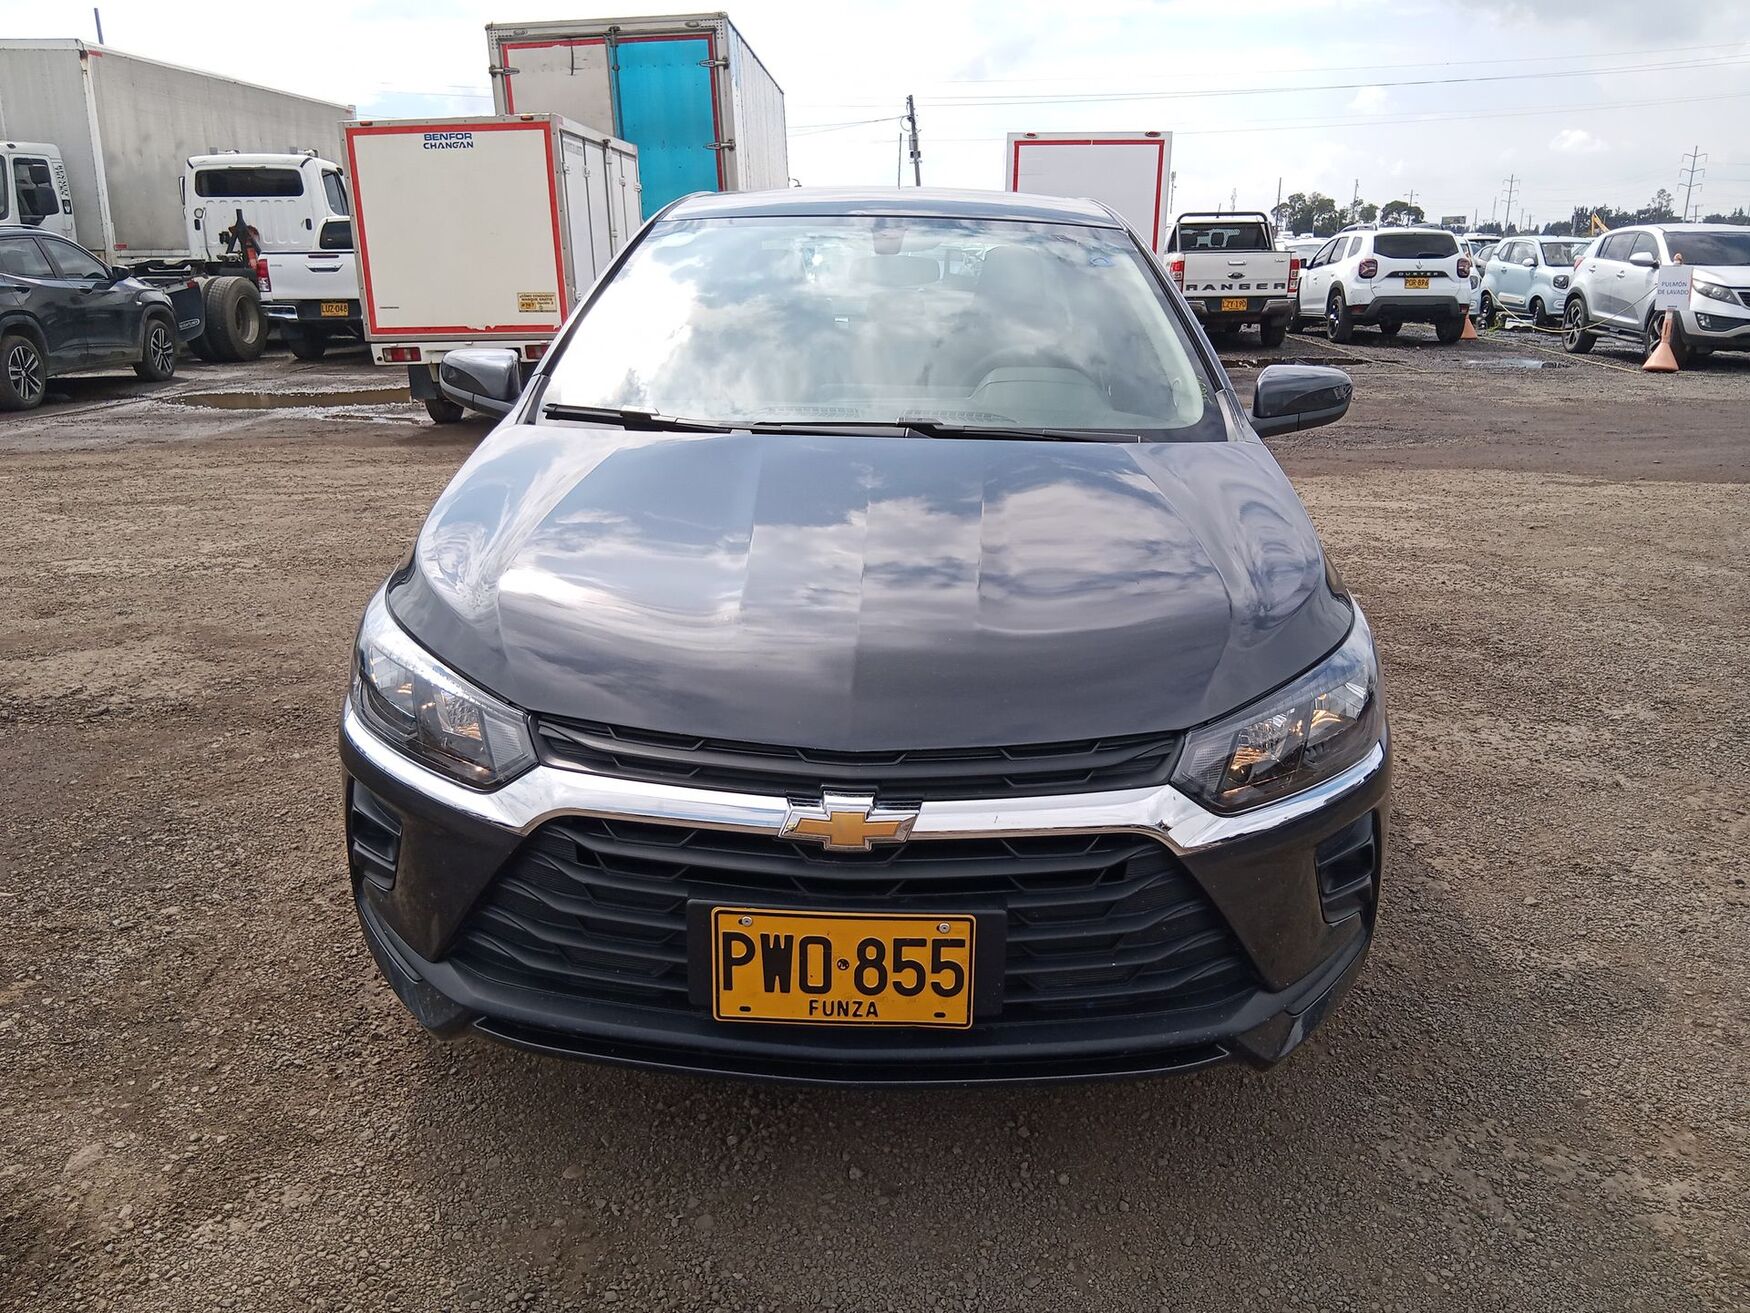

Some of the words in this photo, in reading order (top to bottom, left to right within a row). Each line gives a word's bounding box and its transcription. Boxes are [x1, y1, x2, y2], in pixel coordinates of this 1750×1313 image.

[424, 133, 472, 141] BENFOR
[423, 141, 474, 150] CHANGAN
[1185, 283, 1286, 291] RANGER
[808, 999, 879, 1018] FUNZA
